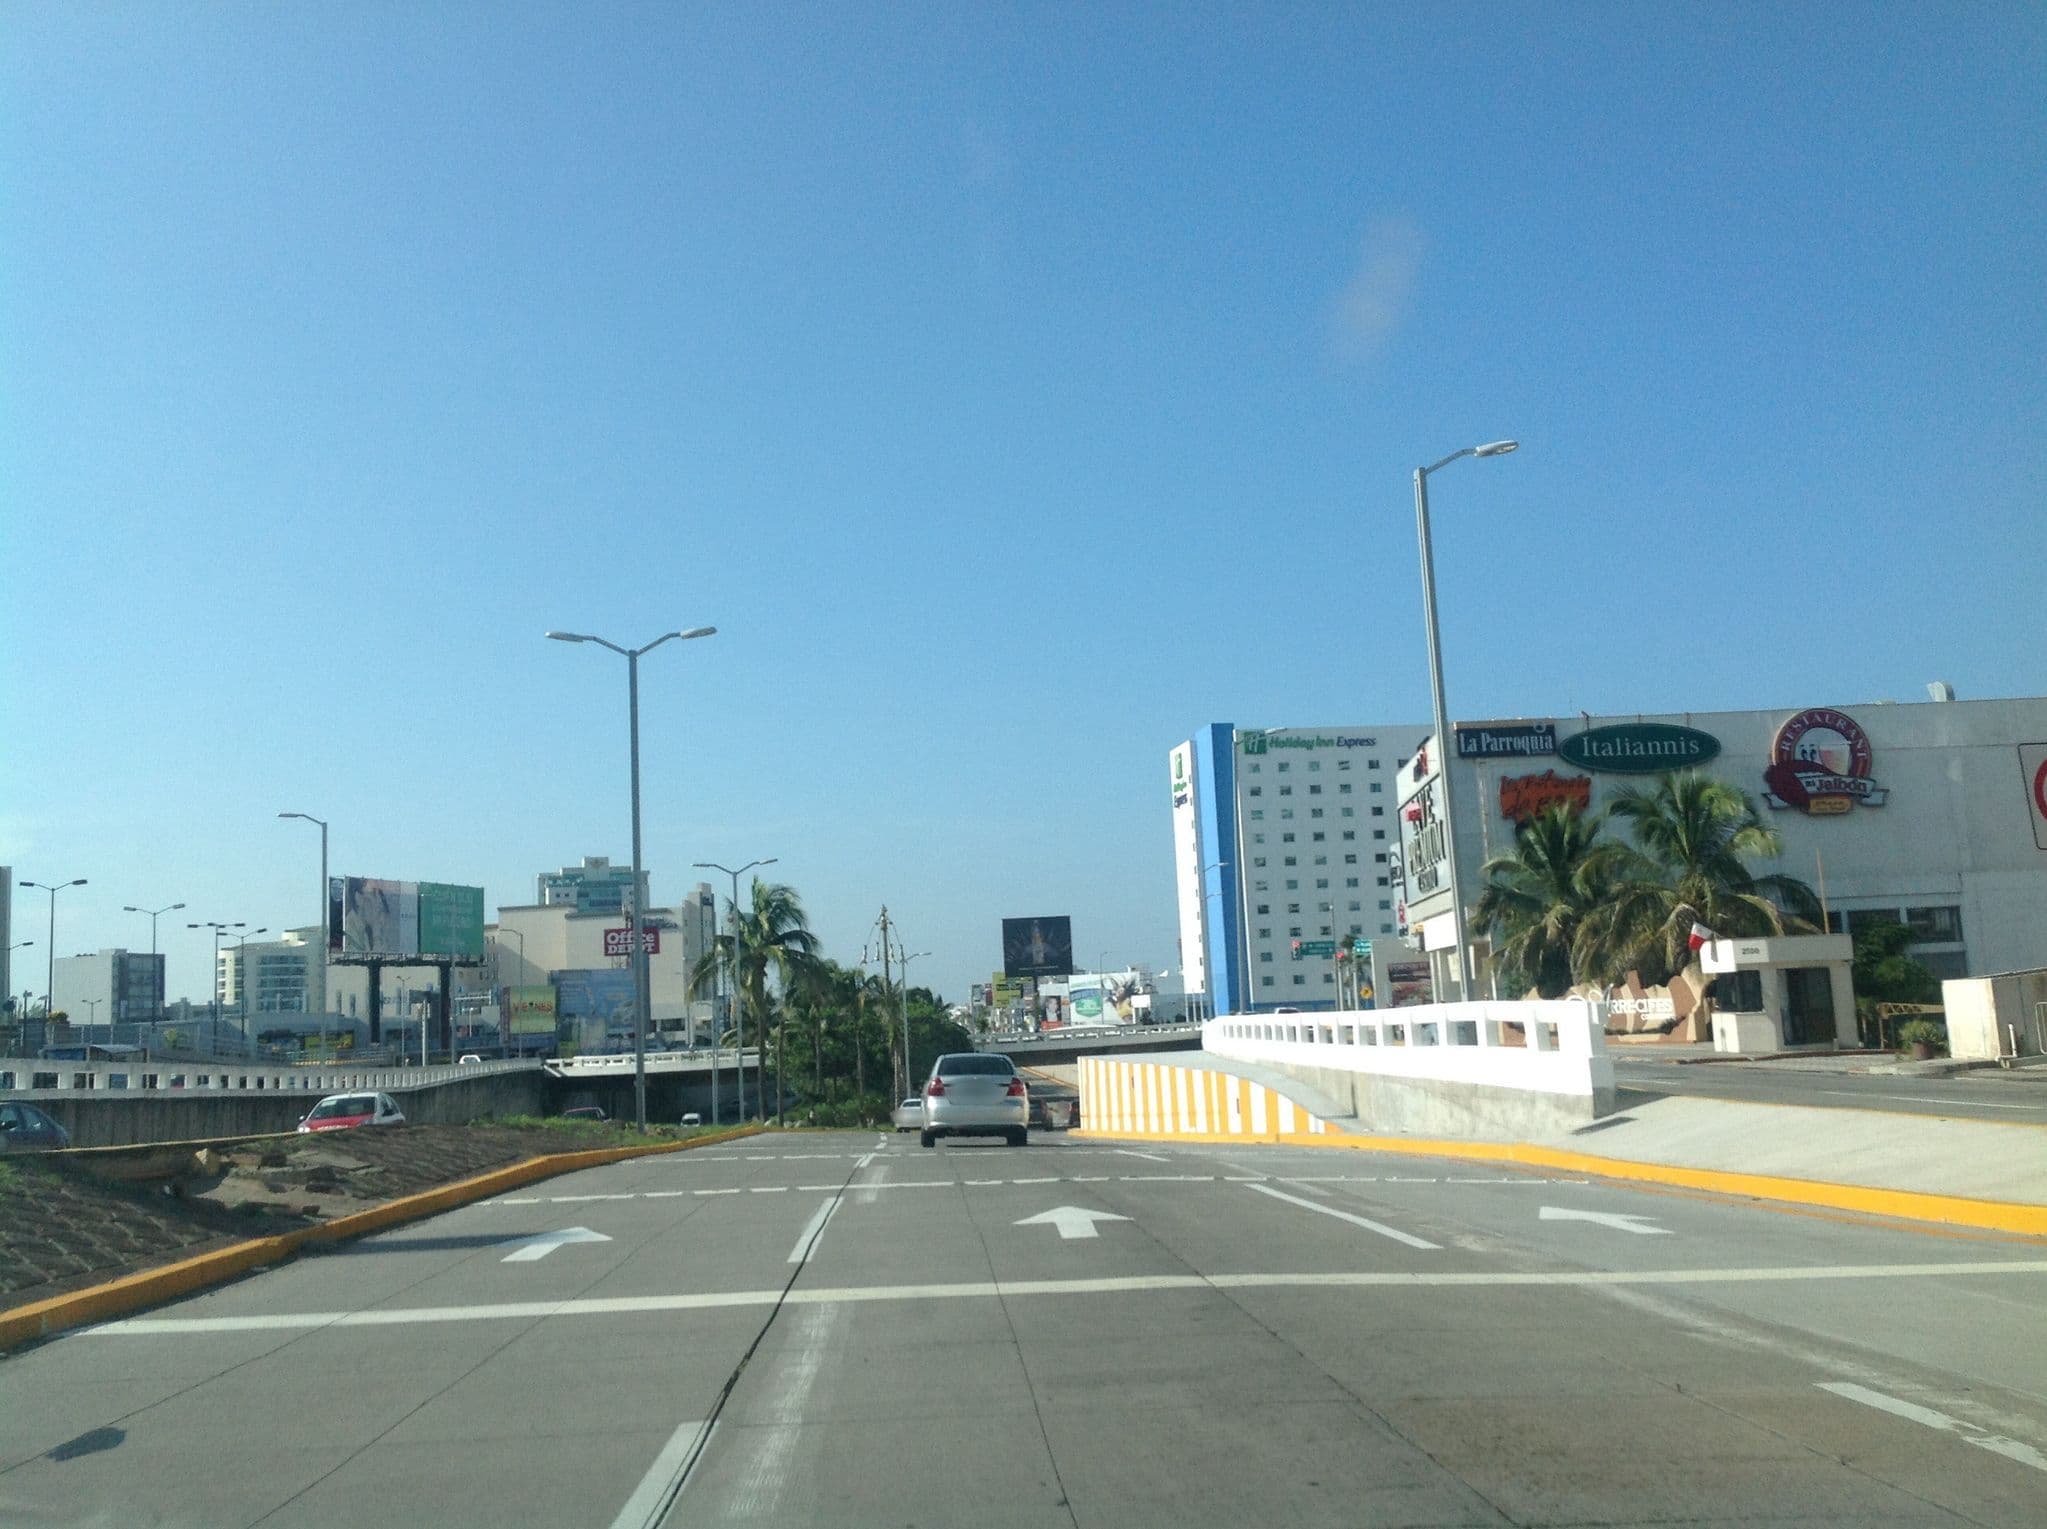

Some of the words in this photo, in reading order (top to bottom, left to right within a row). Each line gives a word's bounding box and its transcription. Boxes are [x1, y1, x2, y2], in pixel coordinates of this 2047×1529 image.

[1781, 713, 1867, 757] RESTAURANT
[1269, 736, 1314, 751] Holiday
[1316, 736, 1335, 747] Inn
[1336, 736, 1377, 749] Express
[1459, 733, 1476, 753] La
[1481, 732, 1553, 755] Parroquia
[606, 931, 655, 945] Offe
[606, 943, 655, 954] DEPT
